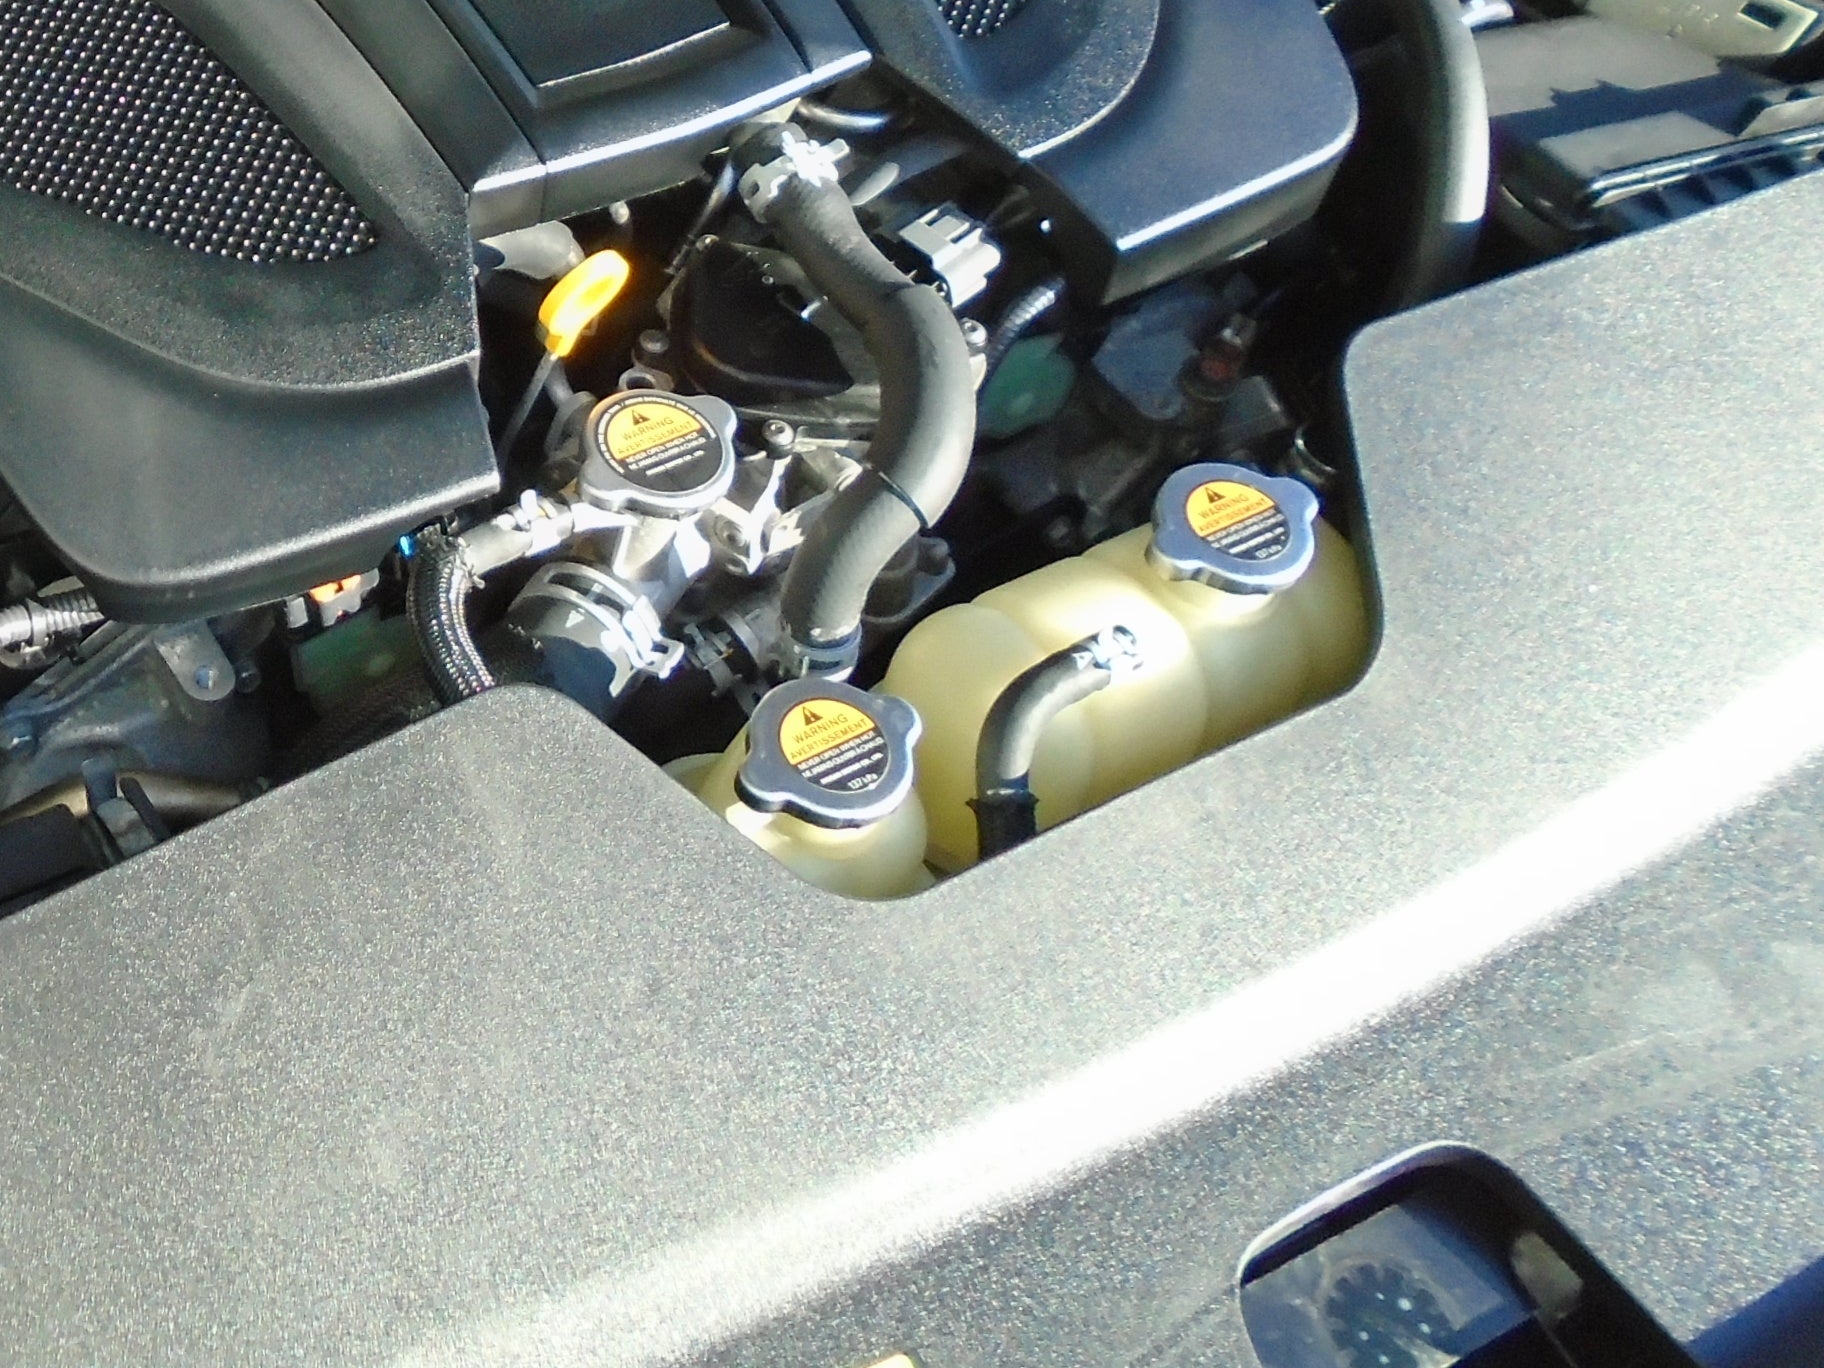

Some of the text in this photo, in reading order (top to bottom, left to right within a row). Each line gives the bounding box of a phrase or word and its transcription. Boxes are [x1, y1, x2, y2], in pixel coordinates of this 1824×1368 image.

[618, 420, 693, 455] AVERTISSEMENT
[621, 417, 674, 441] WARNING
[1198, 493, 1249, 519] WARNING
[790, 718, 868, 759] AVERTISSEMENT
[792, 713, 848, 743] WARNING
